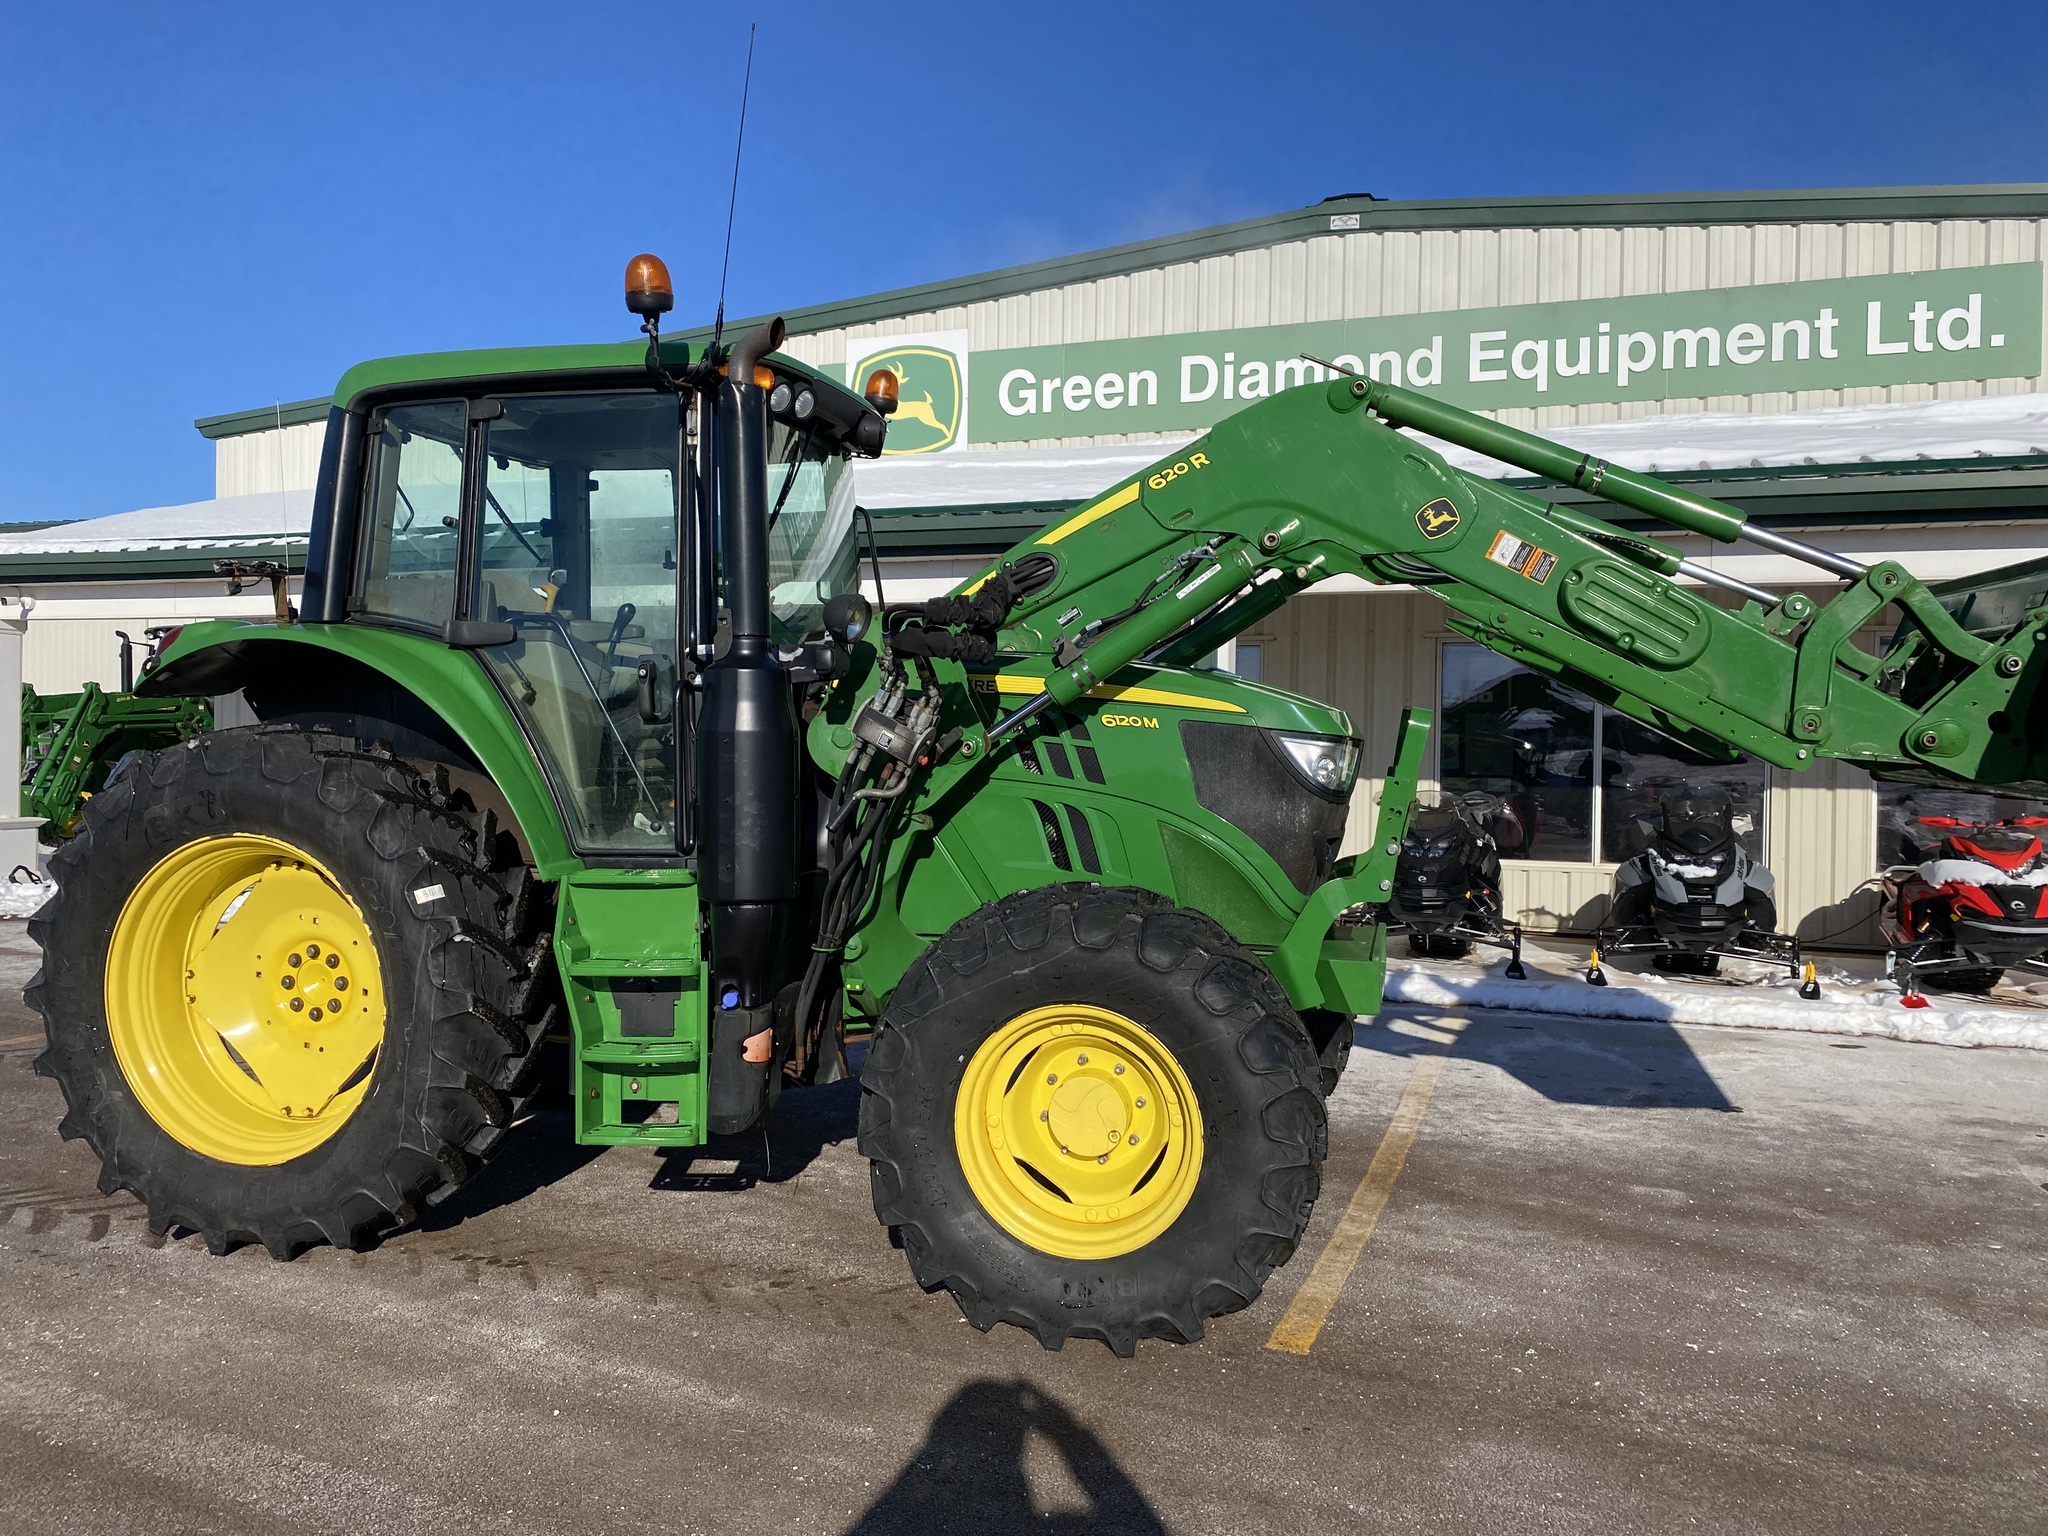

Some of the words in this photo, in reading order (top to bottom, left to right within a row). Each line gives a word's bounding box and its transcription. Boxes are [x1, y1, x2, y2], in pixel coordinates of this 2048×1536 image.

[998, 368, 1158, 416] Green
[1180, 335, 1443, 403] Diamond
[1468, 308, 1839, 392] Equipment
[1866, 293, 2005, 356] Ltd.
[1147, 461, 1190, 490] 620
[1188, 451, 1213, 470] R
[1101, 714, 1142, 727] 6120
[1142, 716, 1160, 729] M
